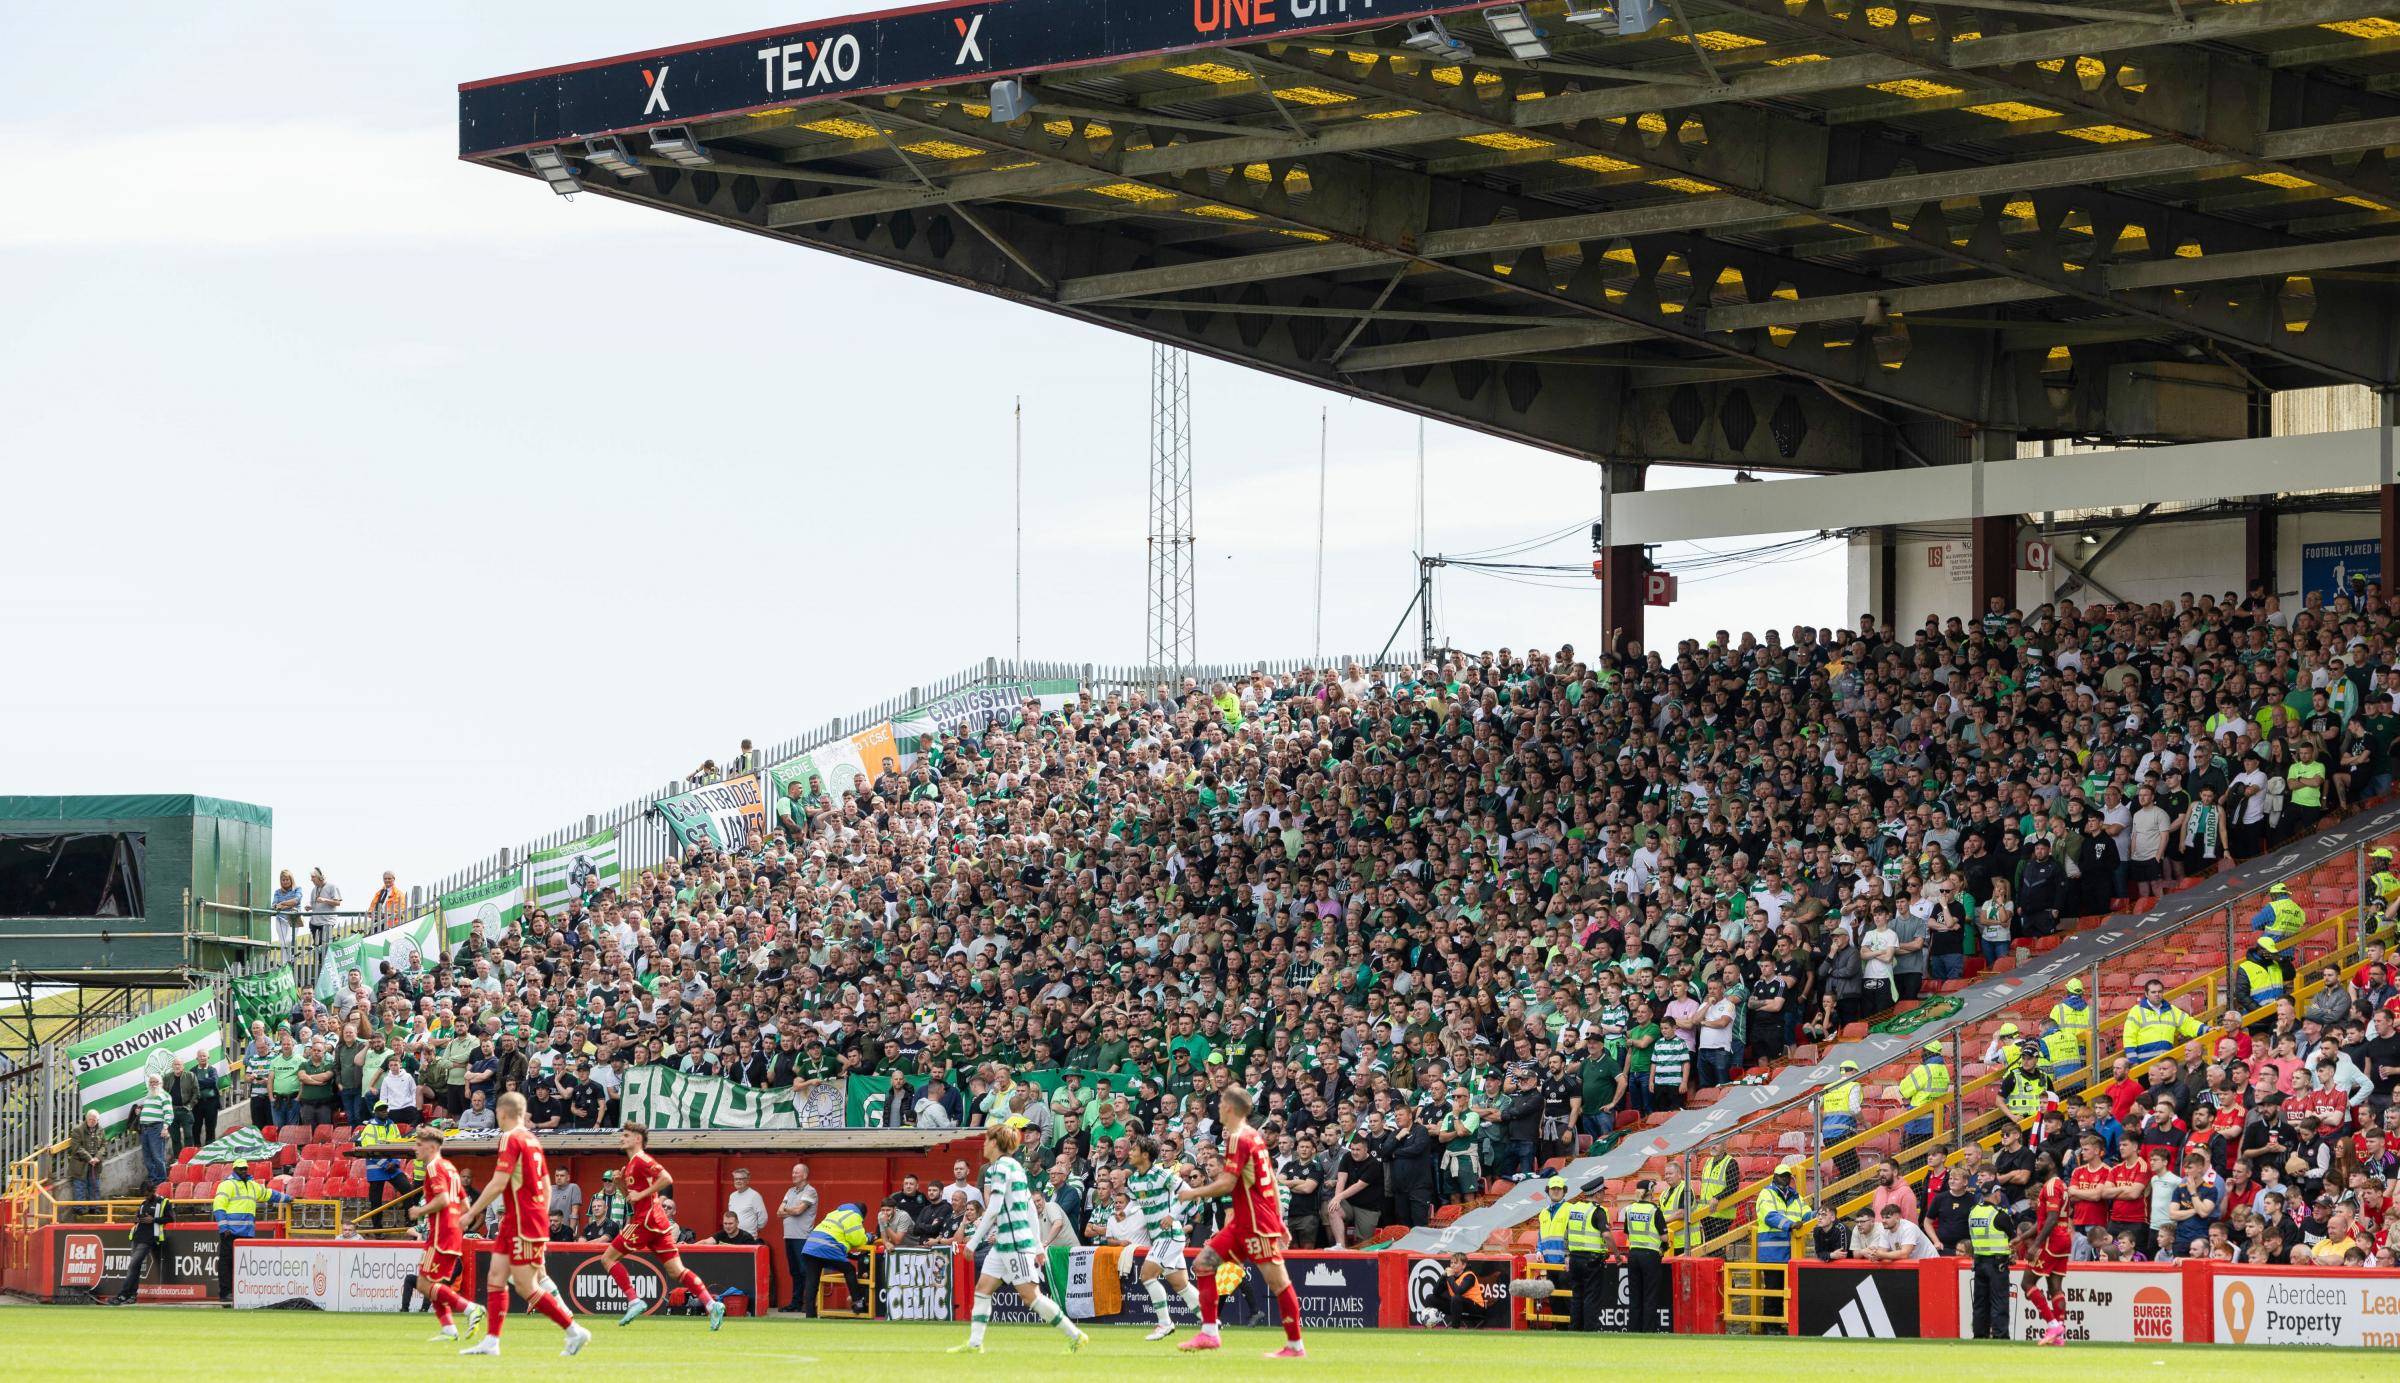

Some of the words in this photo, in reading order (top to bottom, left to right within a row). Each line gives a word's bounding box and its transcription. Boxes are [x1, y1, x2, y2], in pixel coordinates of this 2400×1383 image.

[758, 33, 861, 94] TEXO
[2027, 542, 2045, 570] Q
[2305, 546, 2342, 559] FOOTBALL
[2345, 543, 2372, 556] PLAYED
[1648, 575, 1665, 602] P
[78, 1016, 182, 1072] STORNOWAY
[207, 1002, 214, 1017] 1
[2286, 1111, 2305, 1120] TEXO
[1630, 1213, 1650, 1223] POLICE
[1970, 1218, 1989, 1227] POLICE
[193, 1242, 219, 1253] FAMILY
[1245, 1238, 1261, 1254] 33
[67, 1262, 96, 1274] motors
[105, 1256, 114, 1270] 40
[115, 1255, 130, 1271] YEAR
[175, 1256, 202, 1277] FOR
[238, 1250, 309, 1278] Aberdeen
[888, 1254, 934, 1287] LEITH
[1010, 1258, 1018, 1273] 8
[237, 1280, 284, 1299] Chiropractic
[287, 1281, 309, 1296] Clinic
[350, 1283, 398, 1301] Chiropractic
[576, 1274, 657, 1299] HUTCEON
[1480, 1284, 1507, 1299] PASS
[2266, 1283, 2347, 1306] Aberdeen
[596, 1301, 631, 1311] SERVIC
[887, 1286, 948, 1321] CELTIC
[1297, 1297, 1326, 1312] COTT
[1328, 1297, 1364, 1315] JAMES
[2068, 1288, 2085, 1302] BK
[2088, 1288, 2113, 1306] App
[2025, 1308, 2037, 1320] to
[2133, 1306, 2172, 1318] BURGER
[1299, 1317, 1364, 1328] ASSOCIATES
[2133, 1319, 2172, 1337] KING
[2267, 1310, 2342, 1336] Property
[2063, 1325, 2090, 1340] eals
